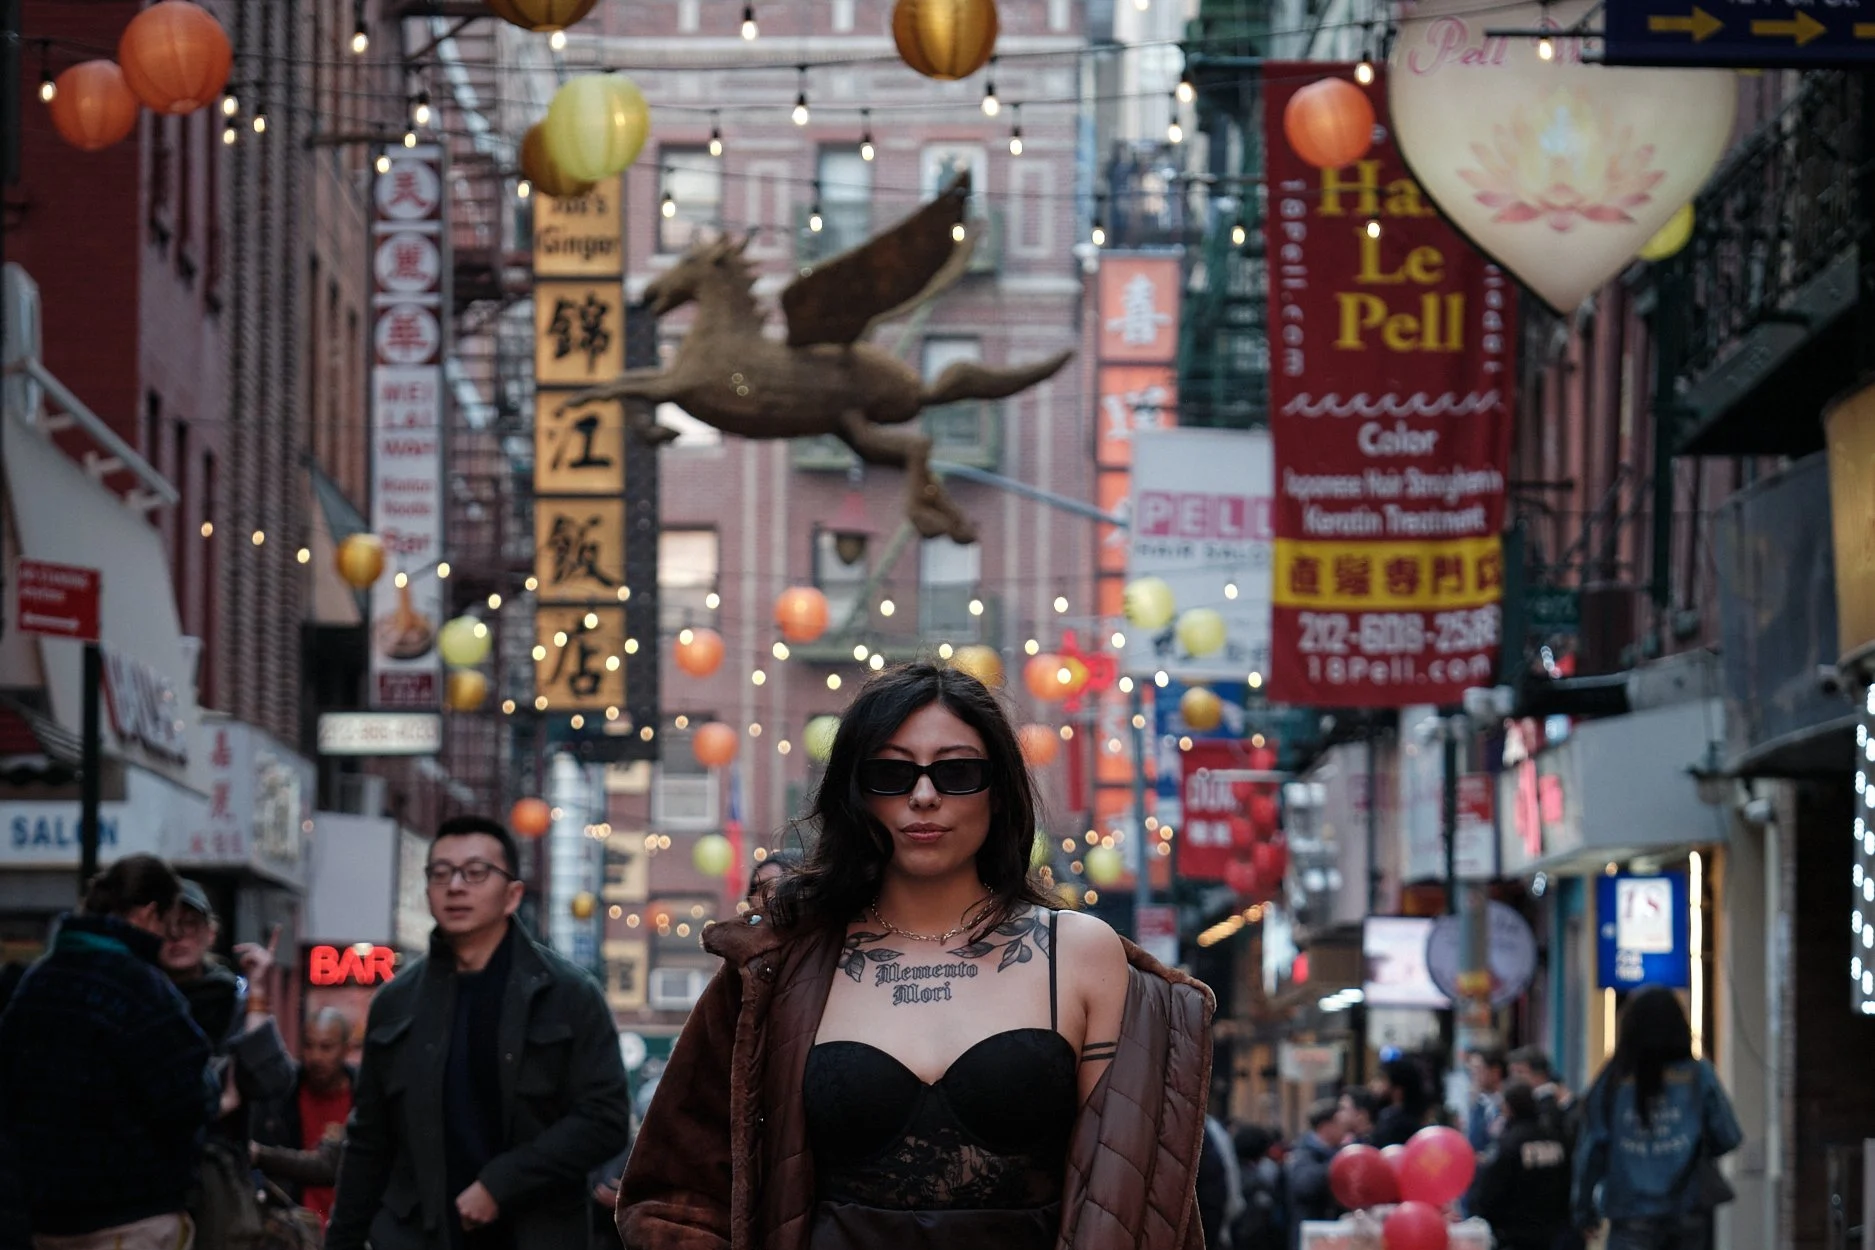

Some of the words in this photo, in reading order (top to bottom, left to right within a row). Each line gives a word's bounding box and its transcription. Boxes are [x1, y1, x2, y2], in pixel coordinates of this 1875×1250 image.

[1357, 220, 1446, 285] Le
[1334, 291, 1466, 352] Pell
[1357, 421, 1440, 457] Color
[1383, 504, 1487, 535] Treatment
[310, 945, 395, 986] BAR
[875, 961, 978, 987] Memento
[892, 981, 952, 1006] Mori
